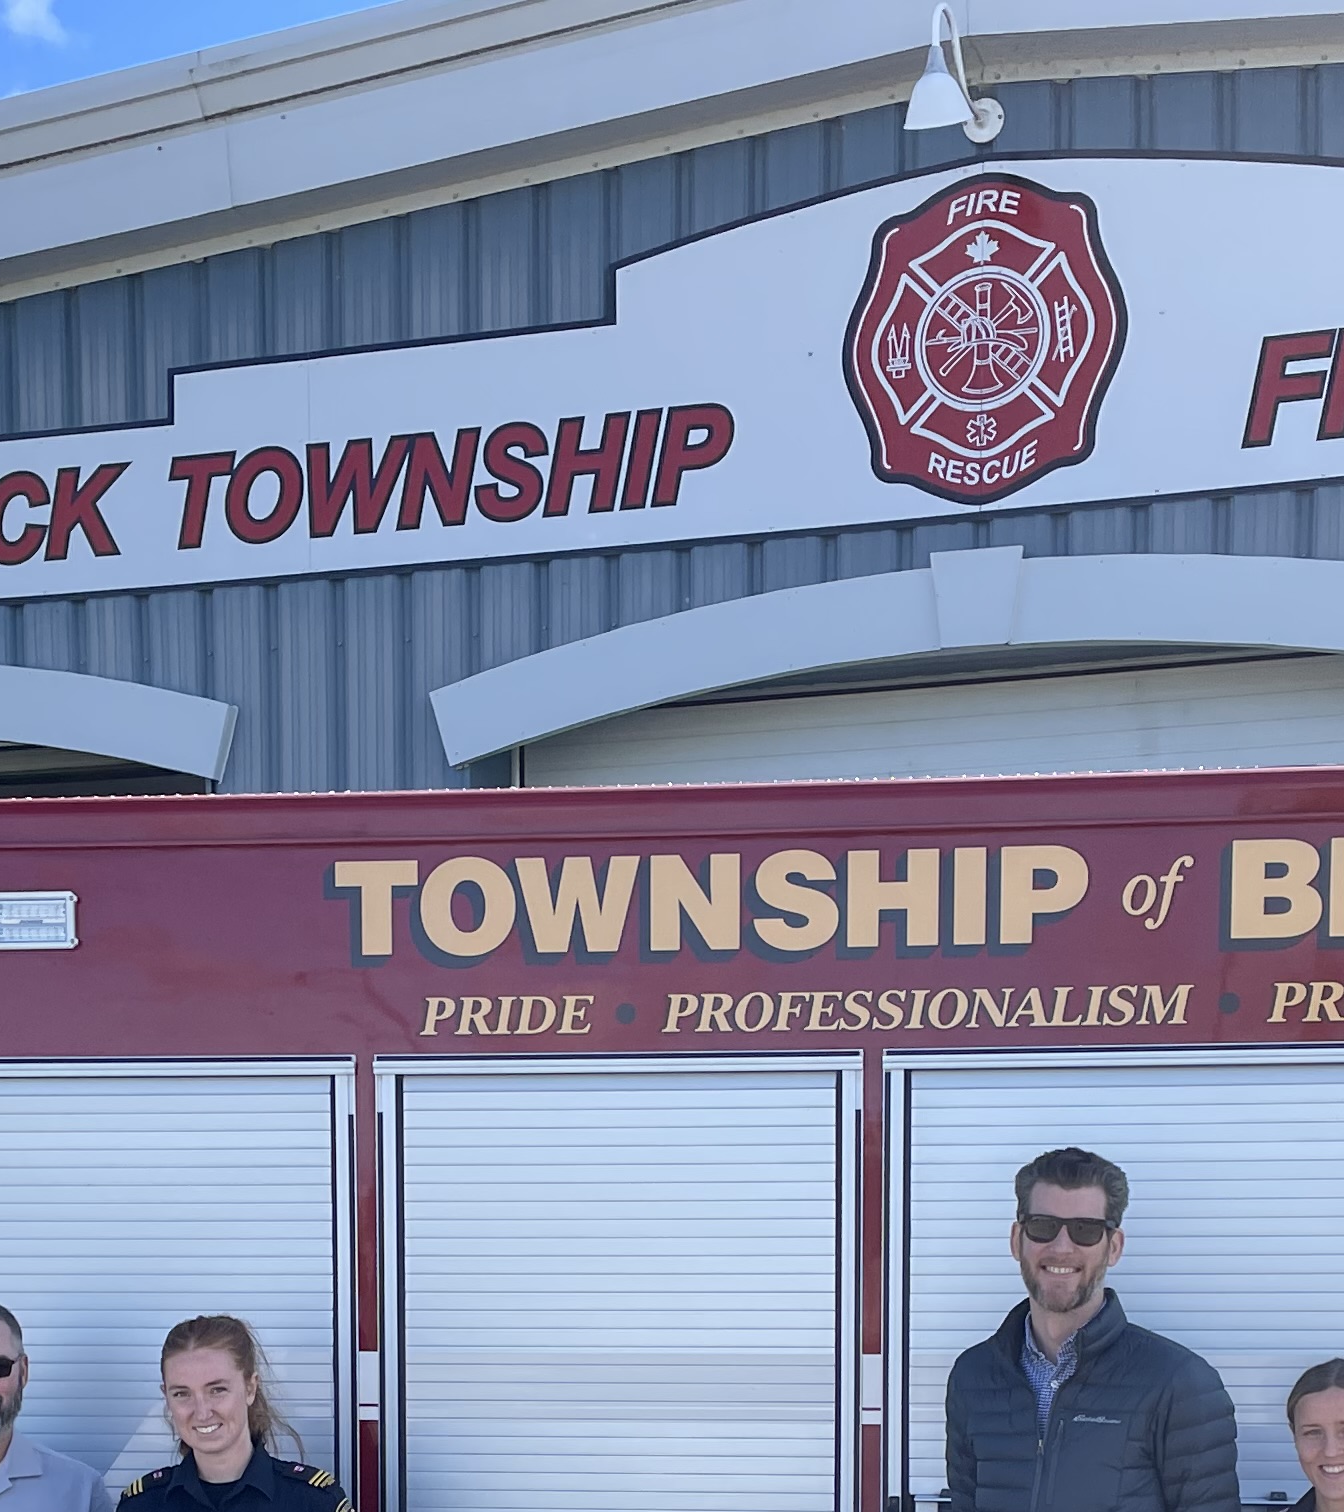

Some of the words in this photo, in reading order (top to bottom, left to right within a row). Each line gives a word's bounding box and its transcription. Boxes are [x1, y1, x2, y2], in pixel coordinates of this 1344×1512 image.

[946, 189, 1021, 226] FIRE
[168, 402, 735, 551] TOWNSHIP
[927, 440, 1039, 486] RESCUE
[333, 838, 1091, 957] TOWNSHIP
[1121, 854, 1196, 935] of
[419, 993, 597, 1039] PRIDE
[658, 982, 1195, 1036] PROFESSIONALISM
